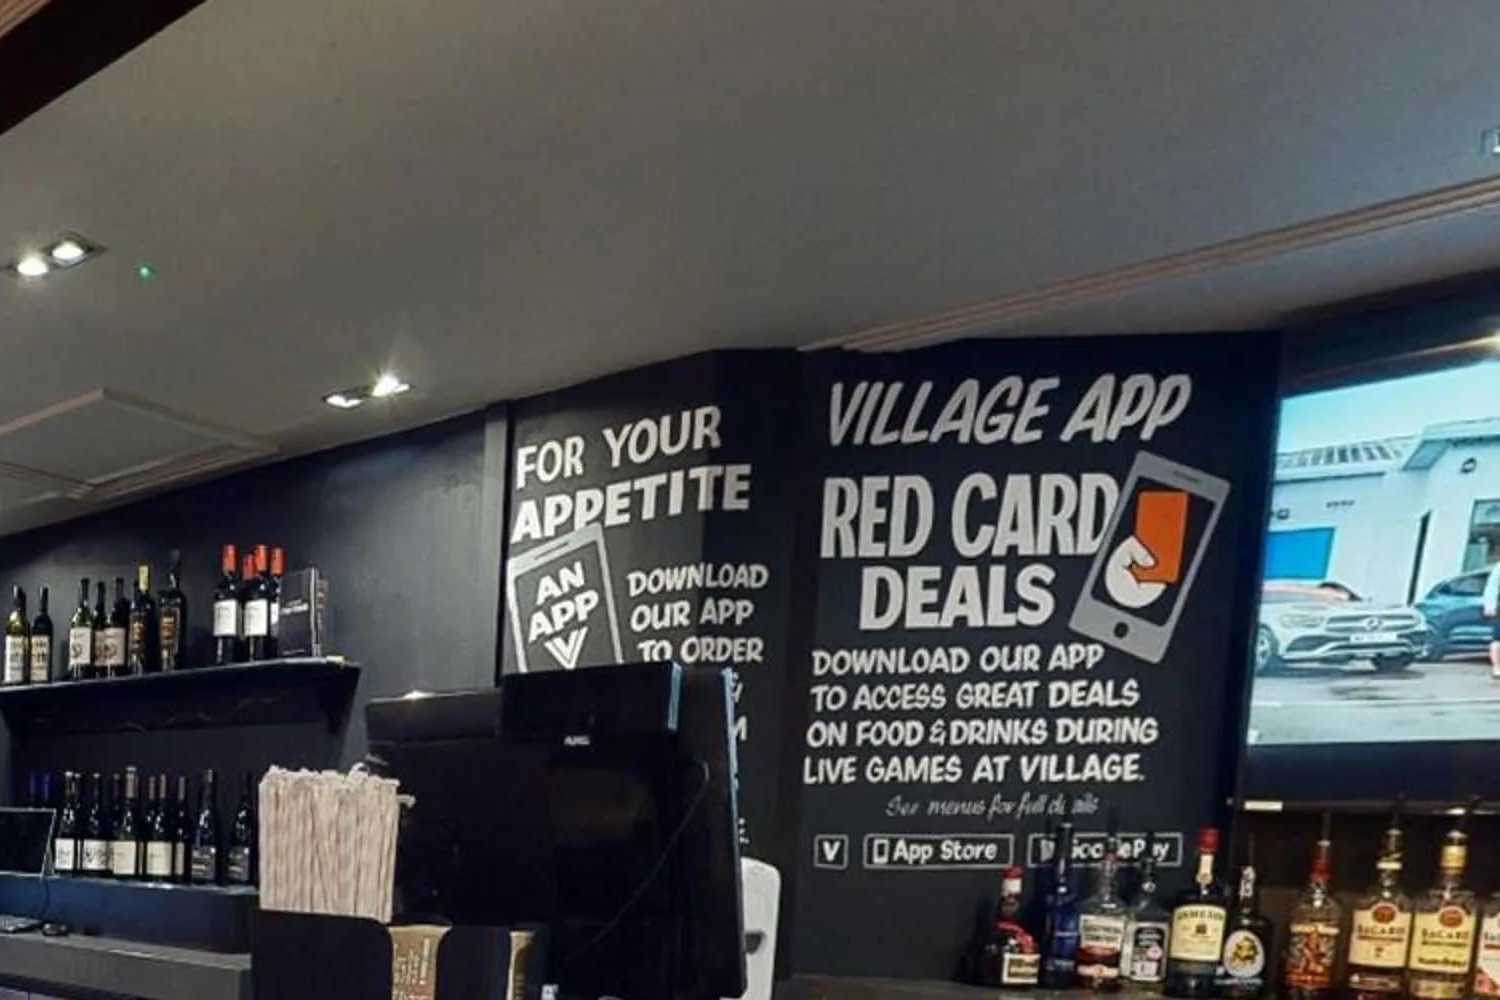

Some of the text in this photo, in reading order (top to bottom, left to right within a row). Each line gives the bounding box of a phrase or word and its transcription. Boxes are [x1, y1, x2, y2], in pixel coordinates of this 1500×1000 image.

[829, 373, 1192, 446] VILLAGE APP
[516, 405, 722, 490] FOR YOUR
[510, 464, 751, 544] APPETITE
[820, 472, 1120, 558] RED CARD
[536, 561, 585, 606] AN
[627, 563, 768, 597] DOWNLOAD
[859, 563, 1056, 631] DEALS
[528, 590, 598, 643] APP
[631, 597, 754, 632] OUR APP
[636, 636, 764, 664] TO ORDER
[812, 643, 1105, 676] DOWNLOAD OUR APP
[810, 678, 1141, 711] TO ACCESS GREAT DEALS
[806, 719, 848, 748] ON
[855, 719, 924, 747] FOOD
[949, 717, 1048, 745] DRINKS
[1055, 716, 1160, 745] DURING
[803, 752, 1146, 784] LIVE GAMES AT VILLAGE.
[886, 793, 920, 817] See
[927, 798, 986, 817] menus
[987, 792, 1016, 823] for
[823, 840, 842, 862] V
[893, 839, 997, 863] App Store
